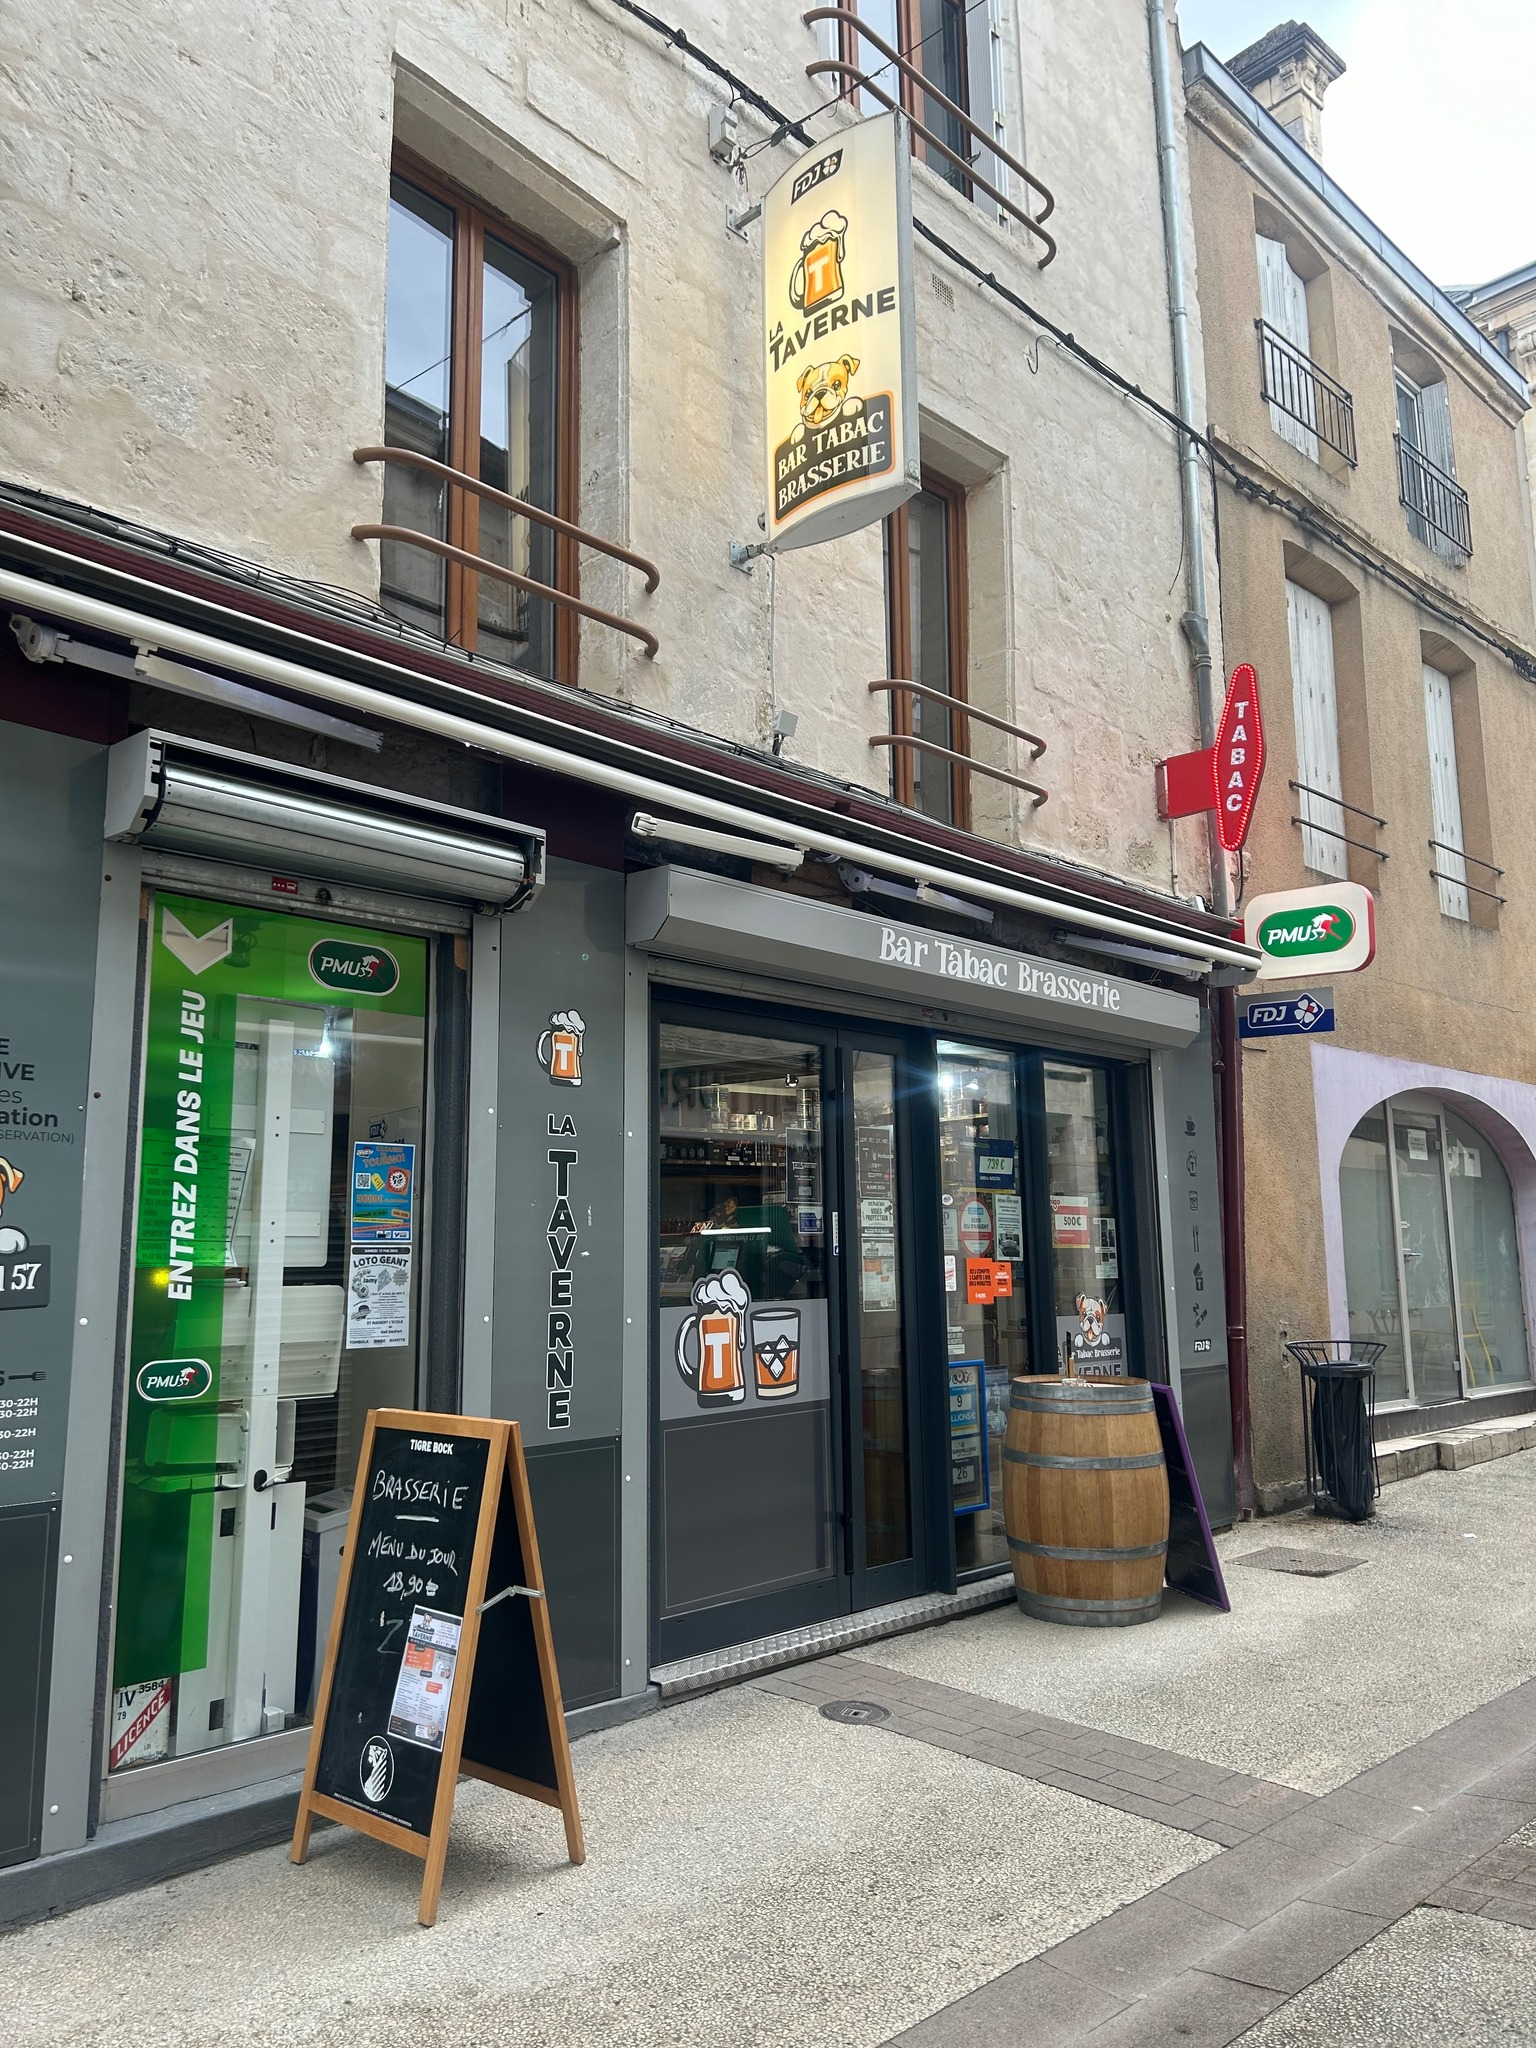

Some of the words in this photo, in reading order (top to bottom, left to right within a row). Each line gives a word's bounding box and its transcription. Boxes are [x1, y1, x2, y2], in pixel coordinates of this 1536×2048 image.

[794, 166, 821, 199] FDJ
[808, 255, 829, 292] T
[770, 286, 896, 372] TAVERNE
[770, 321, 783, 343] LA
[778, 444, 807, 481] BAR
[812, 411, 884, 454] TABAC
[778, 441, 885, 510] BRASSERIE
[1226, 701, 1249, 812] TABAC
[1267, 924, 1312, 946] PMU
[320, 956, 361, 976] PMU
[879, 927, 928, 967] Bar
[935, 940, 1008, 987] Tabac
[1018, 962, 1120, 1011] Brasserie
[182, 989, 206, 1044] JEU
[1252, 1004, 1287, 1024] FDJ
[178, 1048, 203, 1083] LE
[555, 1043, 572, 1070] T
[174, 1089, 201, 1175] DANS
[547, 1112, 577, 1137] LA
[1063, 1216, 1081, 1226] 500€
[167, 1181, 197, 1300] ENTREZ
[11, 1263, 42, 1291] 57
[353, 1256, 378, 1268] LOTO
[380, 1256, 408, 1267] GEANT
[546, 1148, 578, 1430] TAVERNE
[705, 1332, 729, 1379] T
[1076, 1349, 1093, 1359] Tabac
[1094, 1347, 1120, 1358] Brasserie
[146, 1375, 180, 1389] PMU
[957, 1395, 962, 1407] 9
[410, 1439, 432, 1452] TIGRE
[433, 1441, 454, 1455] BOCK
[957, 1465, 968, 1480] 26
[367, 1531, 404, 1559] MENU
[405, 1542, 427, 1560] DU
[427, 1548, 458, 1576] JOUR
[117, 1689, 165, 1760] LICENCE
